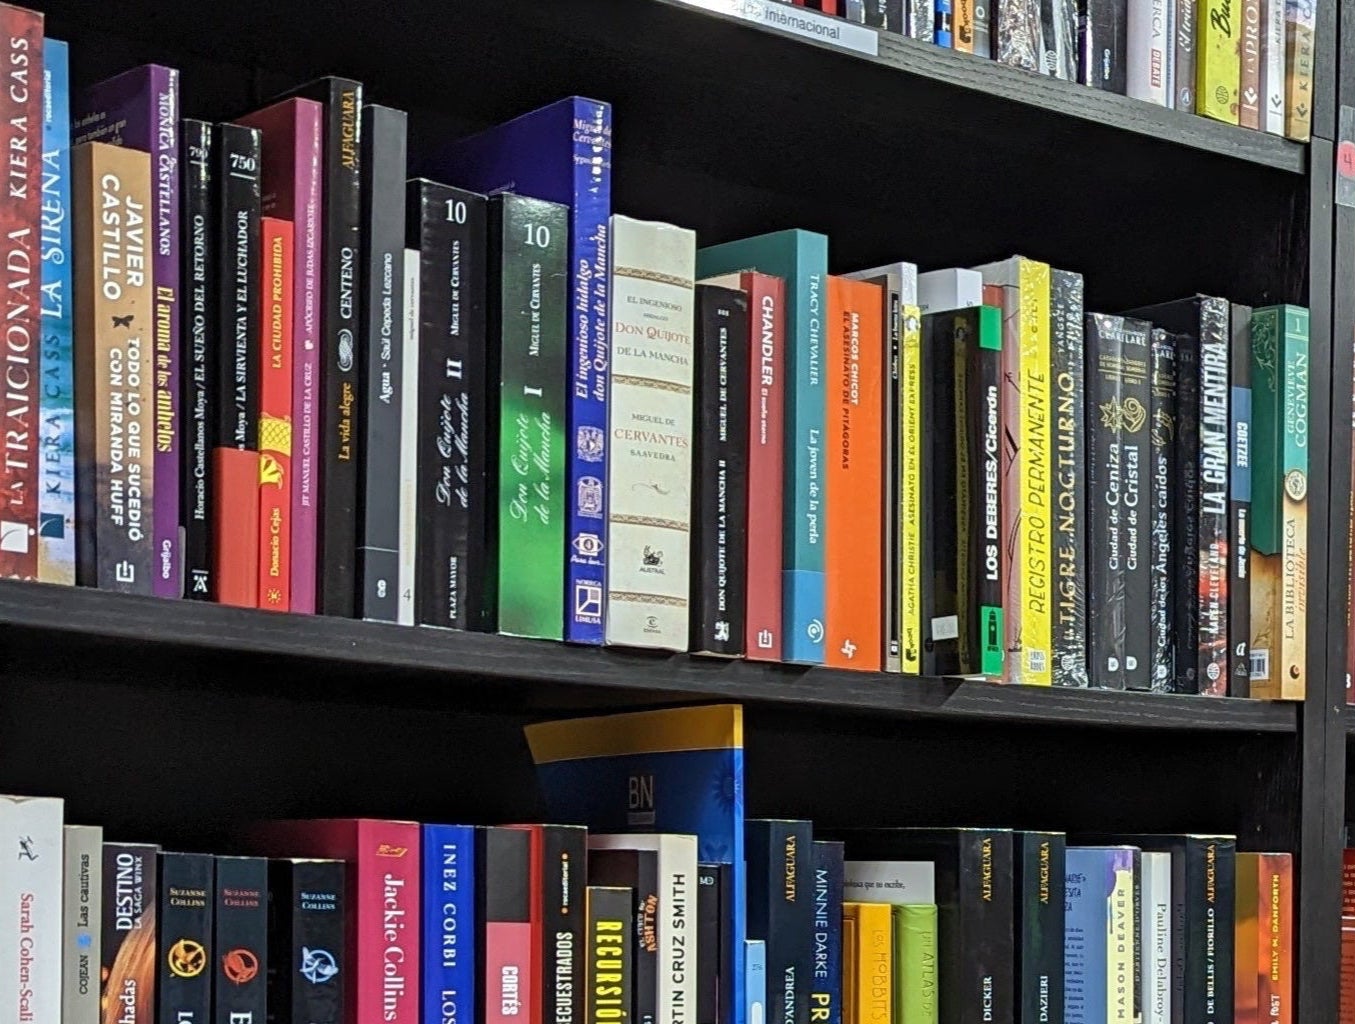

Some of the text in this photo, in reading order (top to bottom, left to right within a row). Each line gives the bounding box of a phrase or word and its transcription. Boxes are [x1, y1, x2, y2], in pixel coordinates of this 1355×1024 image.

[765, 7, 840, 40] Internacional
[10, 37, 28, 199] KIERA CASS
[40, 148, 64, 319] LA SIRENA
[101, 173, 121, 300] CASTILLO
[126, 195, 144, 287] JAVIER
[445, 199, 467, 224] 10
[524, 223, 550, 248] 10
[272, 236, 283, 369] LA CIUDAD PROHIBIDA
[341, 247, 353, 319] CENTENO
[5, 227, 32, 474] TRAICIONADA
[615, 321, 690, 345] DON QUIJOTE
[617, 346, 689, 366] DE LA MANCHA
[761, 295, 774, 386] CHANDLER
[810, 274, 819, 386] TRACY CHEVALIER
[110, 348, 123, 527] CON MIRANDA HUFF
[128, 337, 144, 542] TODO LO QUE SUCEDIÓ
[614, 427, 689, 449] CERVANTES
[1201, 342, 1228, 516] LA GRAN MENTIRA
[1294, 352, 1308, 448] COGMAN
[1236, 421, 1248, 468] COETZEE
[1027, 367, 1047, 615] REGISTRO PERMANENTE
[987, 558, 999, 581] LOS
[1285, 518, 1295, 641] LA BIBLIOTECA
[116, 852, 133, 930] DESTINO
[443, 844, 456, 891] INEZ
[672, 874, 685, 930] SMITH
[21, 893, 34, 933] Sarah
[384, 873, 405, 1022] Jackie Collins
[442, 903, 456, 968] CORBI
[814, 869, 828, 978] MINNIE DARKE
[20, 938, 34, 1022] Cohen-Scali
[501, 965, 519, 1016] CORTÉS
[672, 936, 684, 983] CRUZ
[983, 976, 992, 1022] DICKER
